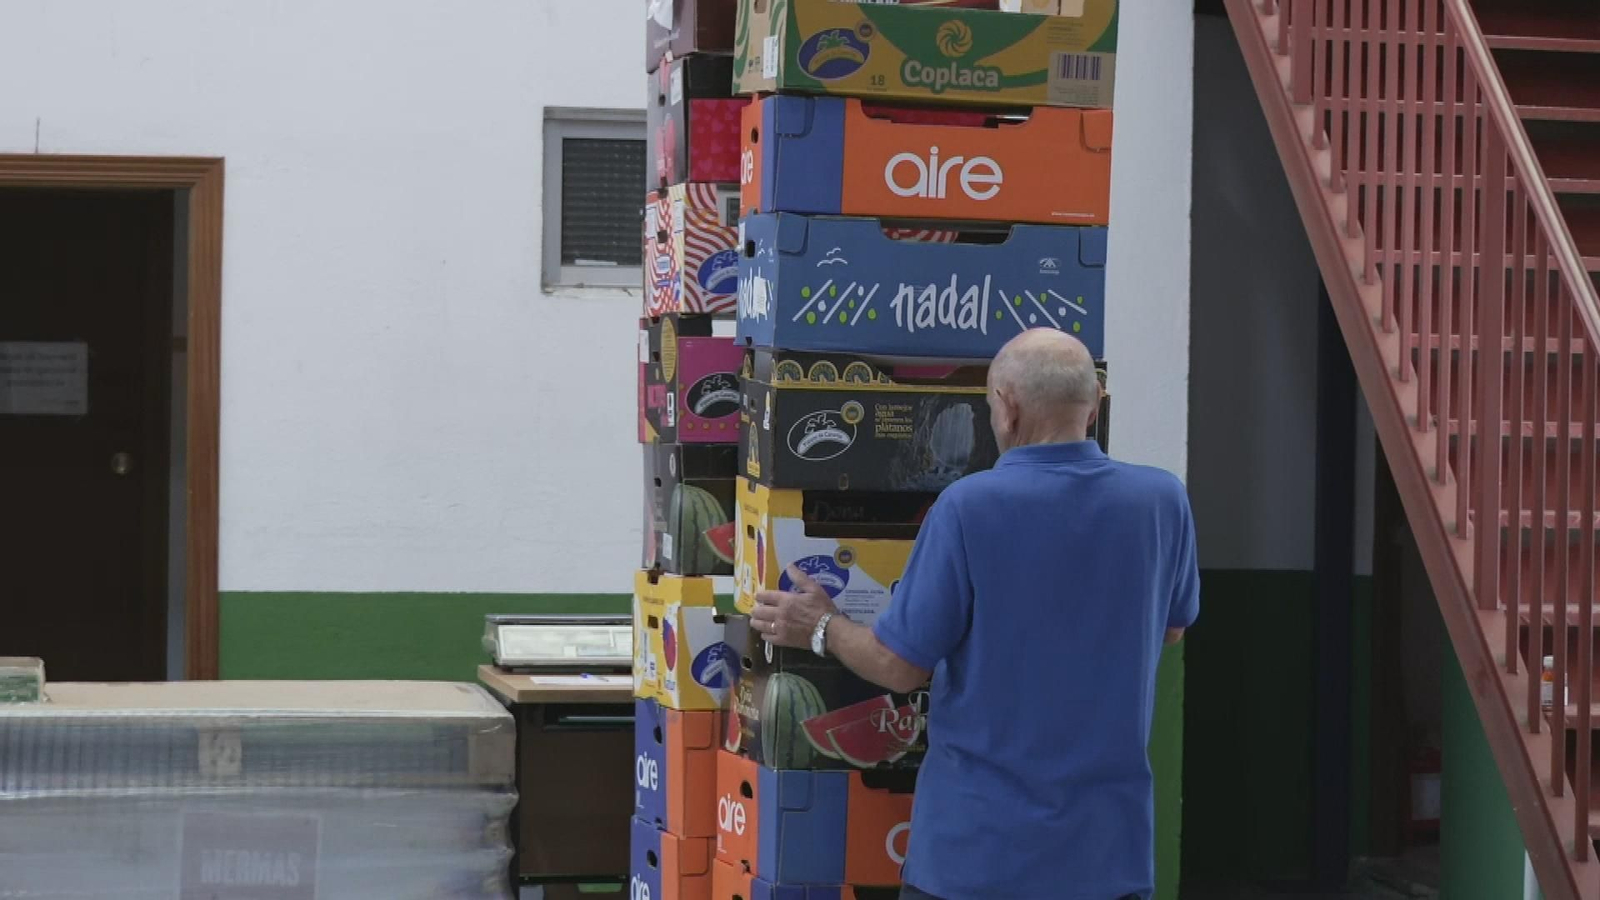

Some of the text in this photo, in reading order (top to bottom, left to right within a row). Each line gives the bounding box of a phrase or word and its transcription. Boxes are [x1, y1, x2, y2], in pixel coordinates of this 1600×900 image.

[870, 74, 885, 86] 18
[904, 60, 999, 90] Coplaca
[884, 146, 1003, 200] aire
[889, 273, 992, 335] nadal
[636, 751, 658, 791] aire
[718, 793, 746, 836] aire
